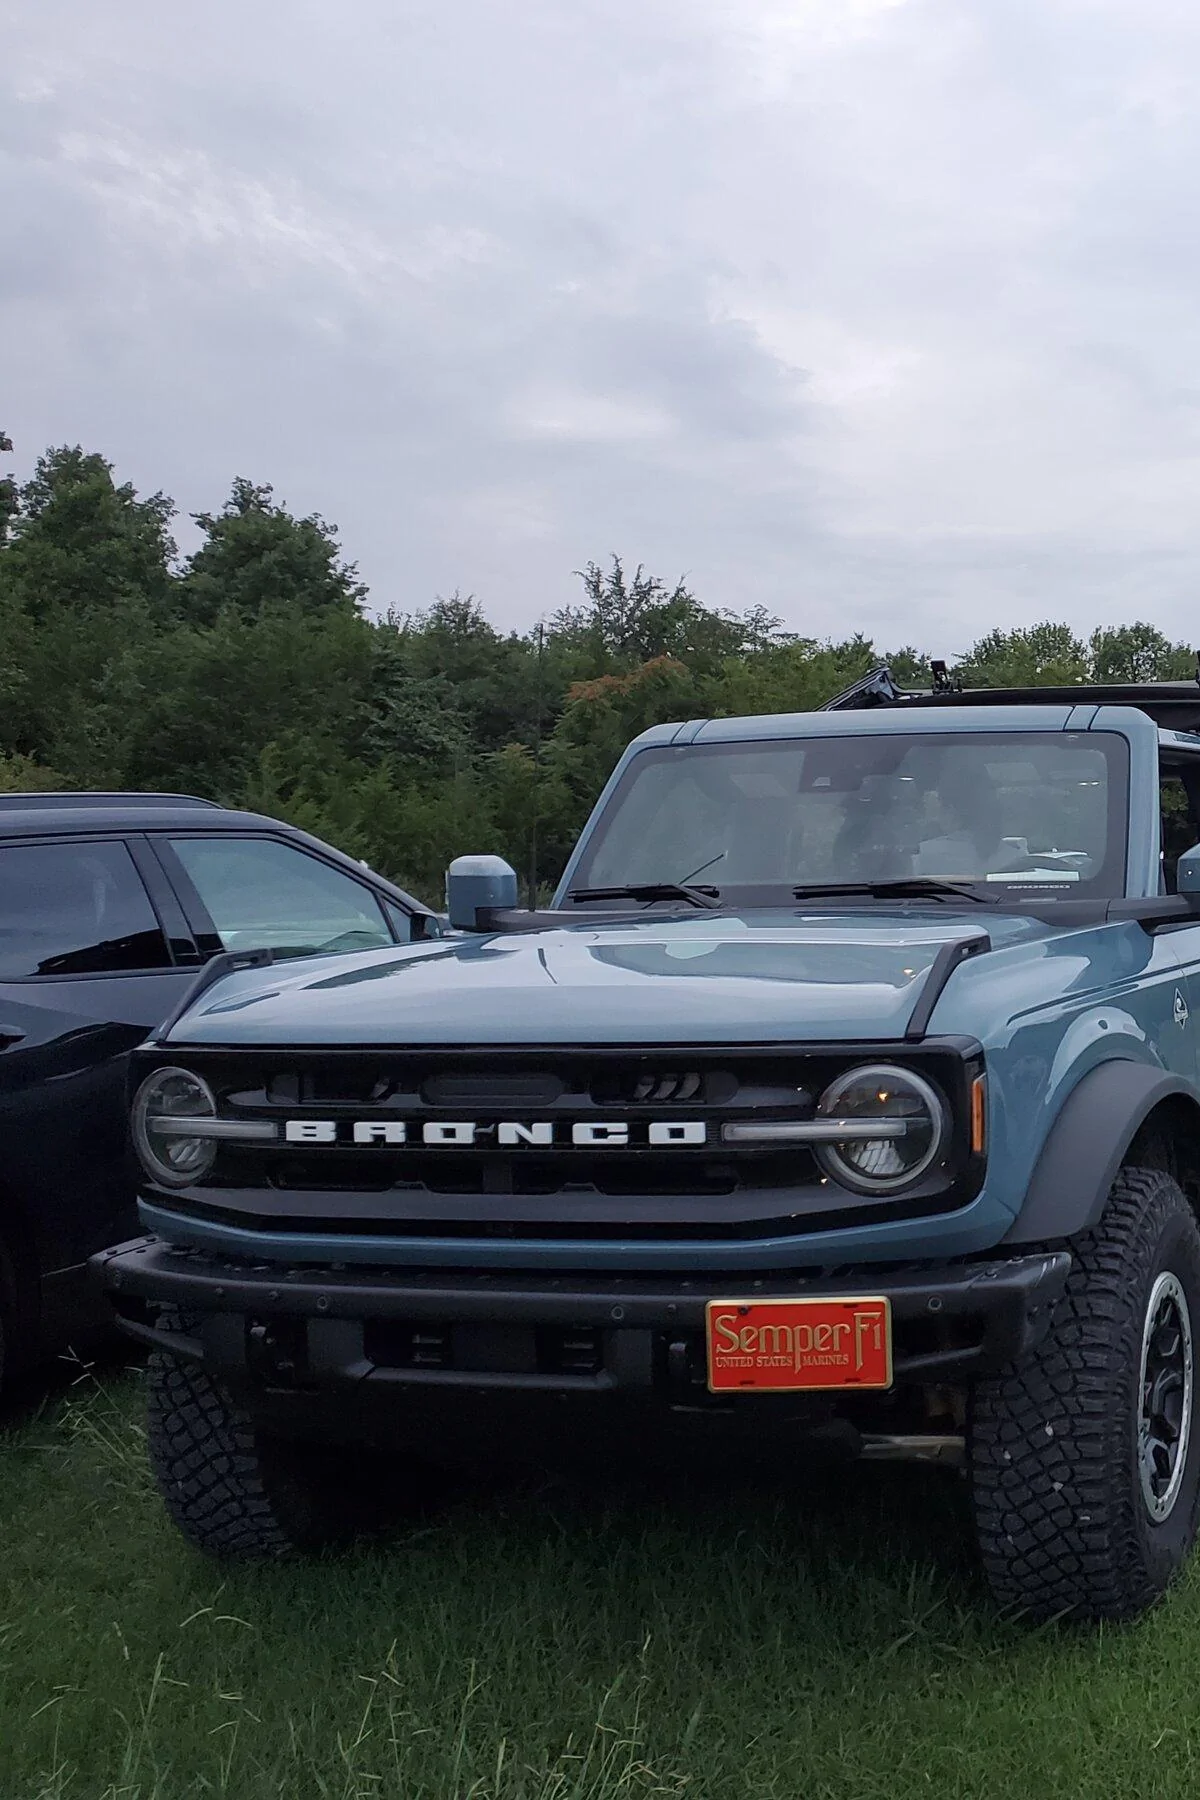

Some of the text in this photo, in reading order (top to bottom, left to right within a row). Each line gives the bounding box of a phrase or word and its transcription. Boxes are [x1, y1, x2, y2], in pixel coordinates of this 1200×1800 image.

[285, 1120, 706, 1144] BRONCO
[715, 1311, 881, 1373] Semper Fi
[715, 1354, 849, 1368] UNITED STATES MARINES
